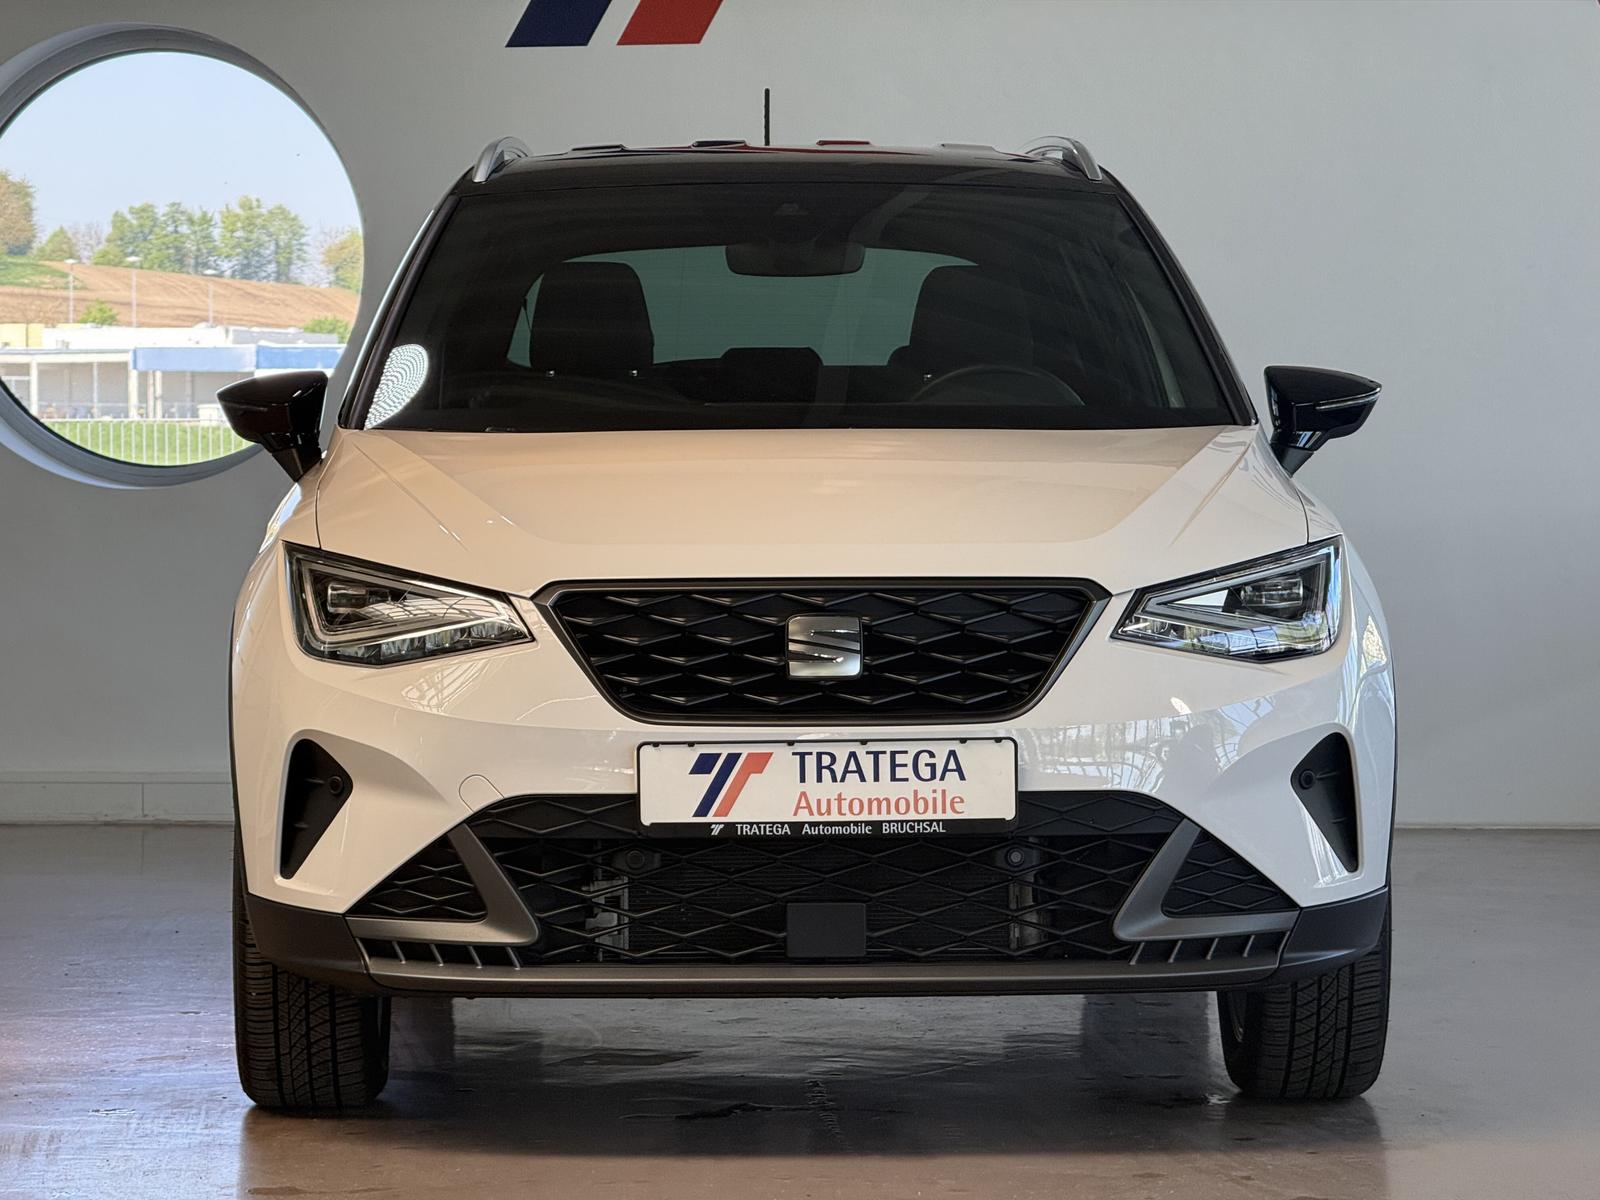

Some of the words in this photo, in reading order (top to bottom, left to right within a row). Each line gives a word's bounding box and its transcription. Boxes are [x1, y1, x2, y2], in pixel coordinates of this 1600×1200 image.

[791, 749, 967, 783] TRATEGA
[792, 788, 965, 817] Automobile
[735, 824, 791, 835] TRATEGA
[801, 823, 873, 835] Automobile
[881, 821, 946, 834] BRUCHSAL
